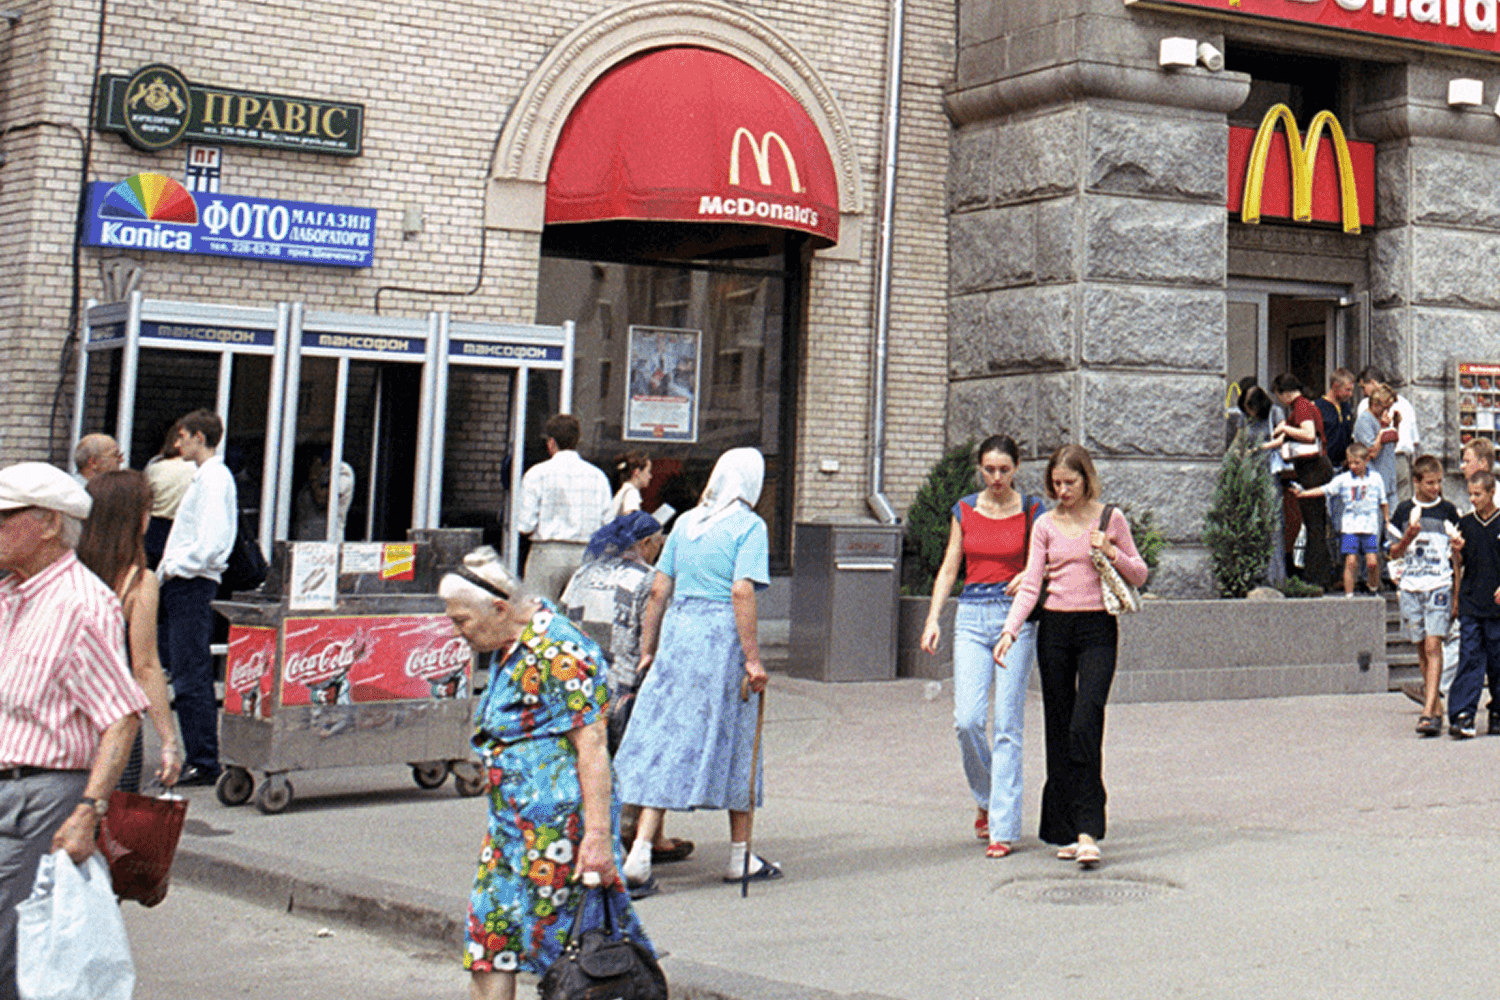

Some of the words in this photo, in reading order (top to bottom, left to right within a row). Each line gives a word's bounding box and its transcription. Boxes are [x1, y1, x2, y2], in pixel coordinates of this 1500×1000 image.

[201, 91, 349, 139] ПРАВІС
[202, 200, 290, 241] ФОТО
[291, 208, 371, 231] МАГАЗИН
[698, 195, 819, 227] McDonald's
[101, 221, 193, 251] Konica
[289, 225, 371, 247] ЛАБОРАТОРІЯ
[157, 325, 256, 343] таксофон
[318, 333, 410, 353] таксофон
[462, 342, 548, 359] таксофон
